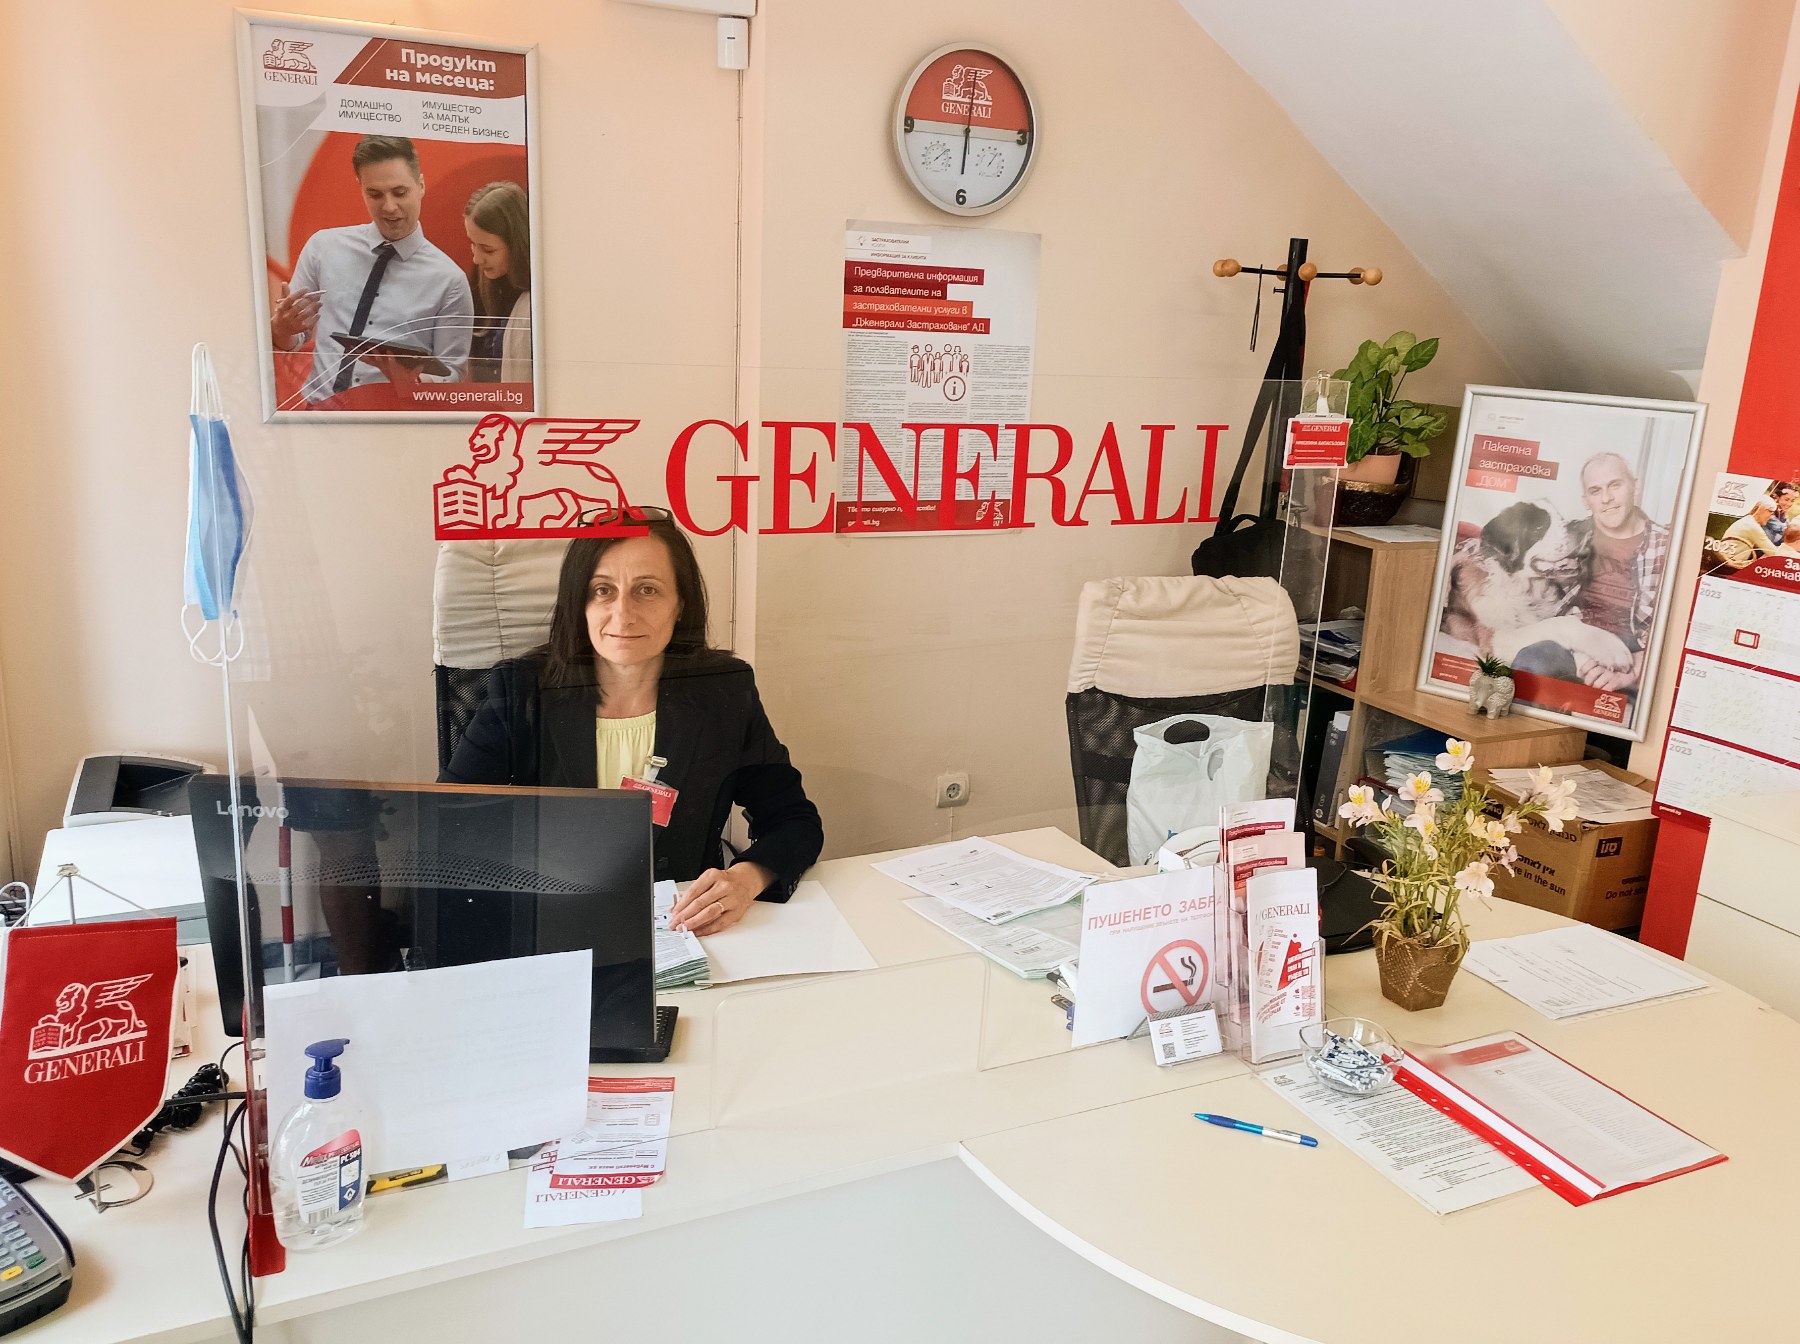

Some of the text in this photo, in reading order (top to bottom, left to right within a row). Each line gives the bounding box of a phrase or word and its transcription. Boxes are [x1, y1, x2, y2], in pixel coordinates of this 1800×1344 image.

[401, 48, 496, 73] Продукт
[264, 71, 318, 86] GENERALI
[385, 68, 495, 91] на месеца:
[340, 99, 393, 111] ДОМАШНО
[422, 100, 482, 115] ИМУЩЕСТВО
[941, 101, 992, 118] GENERALI
[338, 110, 402, 123] ИМУЩЕСТВО
[422, 112, 470, 124] ЗА МАЛЪК
[422, 122, 510, 139] И СРЕДЕН БИЗНЕС
[904, 116, 915, 133] 9
[1016, 129, 1027, 145] 3
[955, 189, 967, 205] 6
[854, 267, 979, 283] Предварителна информация
[853, 285, 863, 293] за
[865, 285, 930, 297] ползвателите
[852, 302, 932, 314] застрахователни
[933, 307, 960, 316] услуги
[971, 323, 985, 332] АД
[413, 390, 523, 404] www.generali.bg
[1482, 440, 1532, 456] Пакетна
[1479, 459, 1551, 476] застраховка
[665, 419, 1230, 536] GENERALI
[1704, 539, 1738, 555] 2023
[1699, 588, 1722, 599] 2023
[1684, 666, 1708, 679] 2023
[1593, 708, 1621, 719] GENERALI
[1668, 743, 1693, 756] 2023
[1523, 870, 1566, 896] in the sun
[1605, 890, 1618, 899] Do
[1618, 887, 1633, 898] not
[1088, 903, 1172, 930] ПУШЕНЕТО
[1261, 903, 1311, 920] GENERALI
[24, 1040, 146, 1084] GENERALI
[557, 1176, 637, 1186] GENERALI
[535, 1189, 611, 1202] GENERALI
